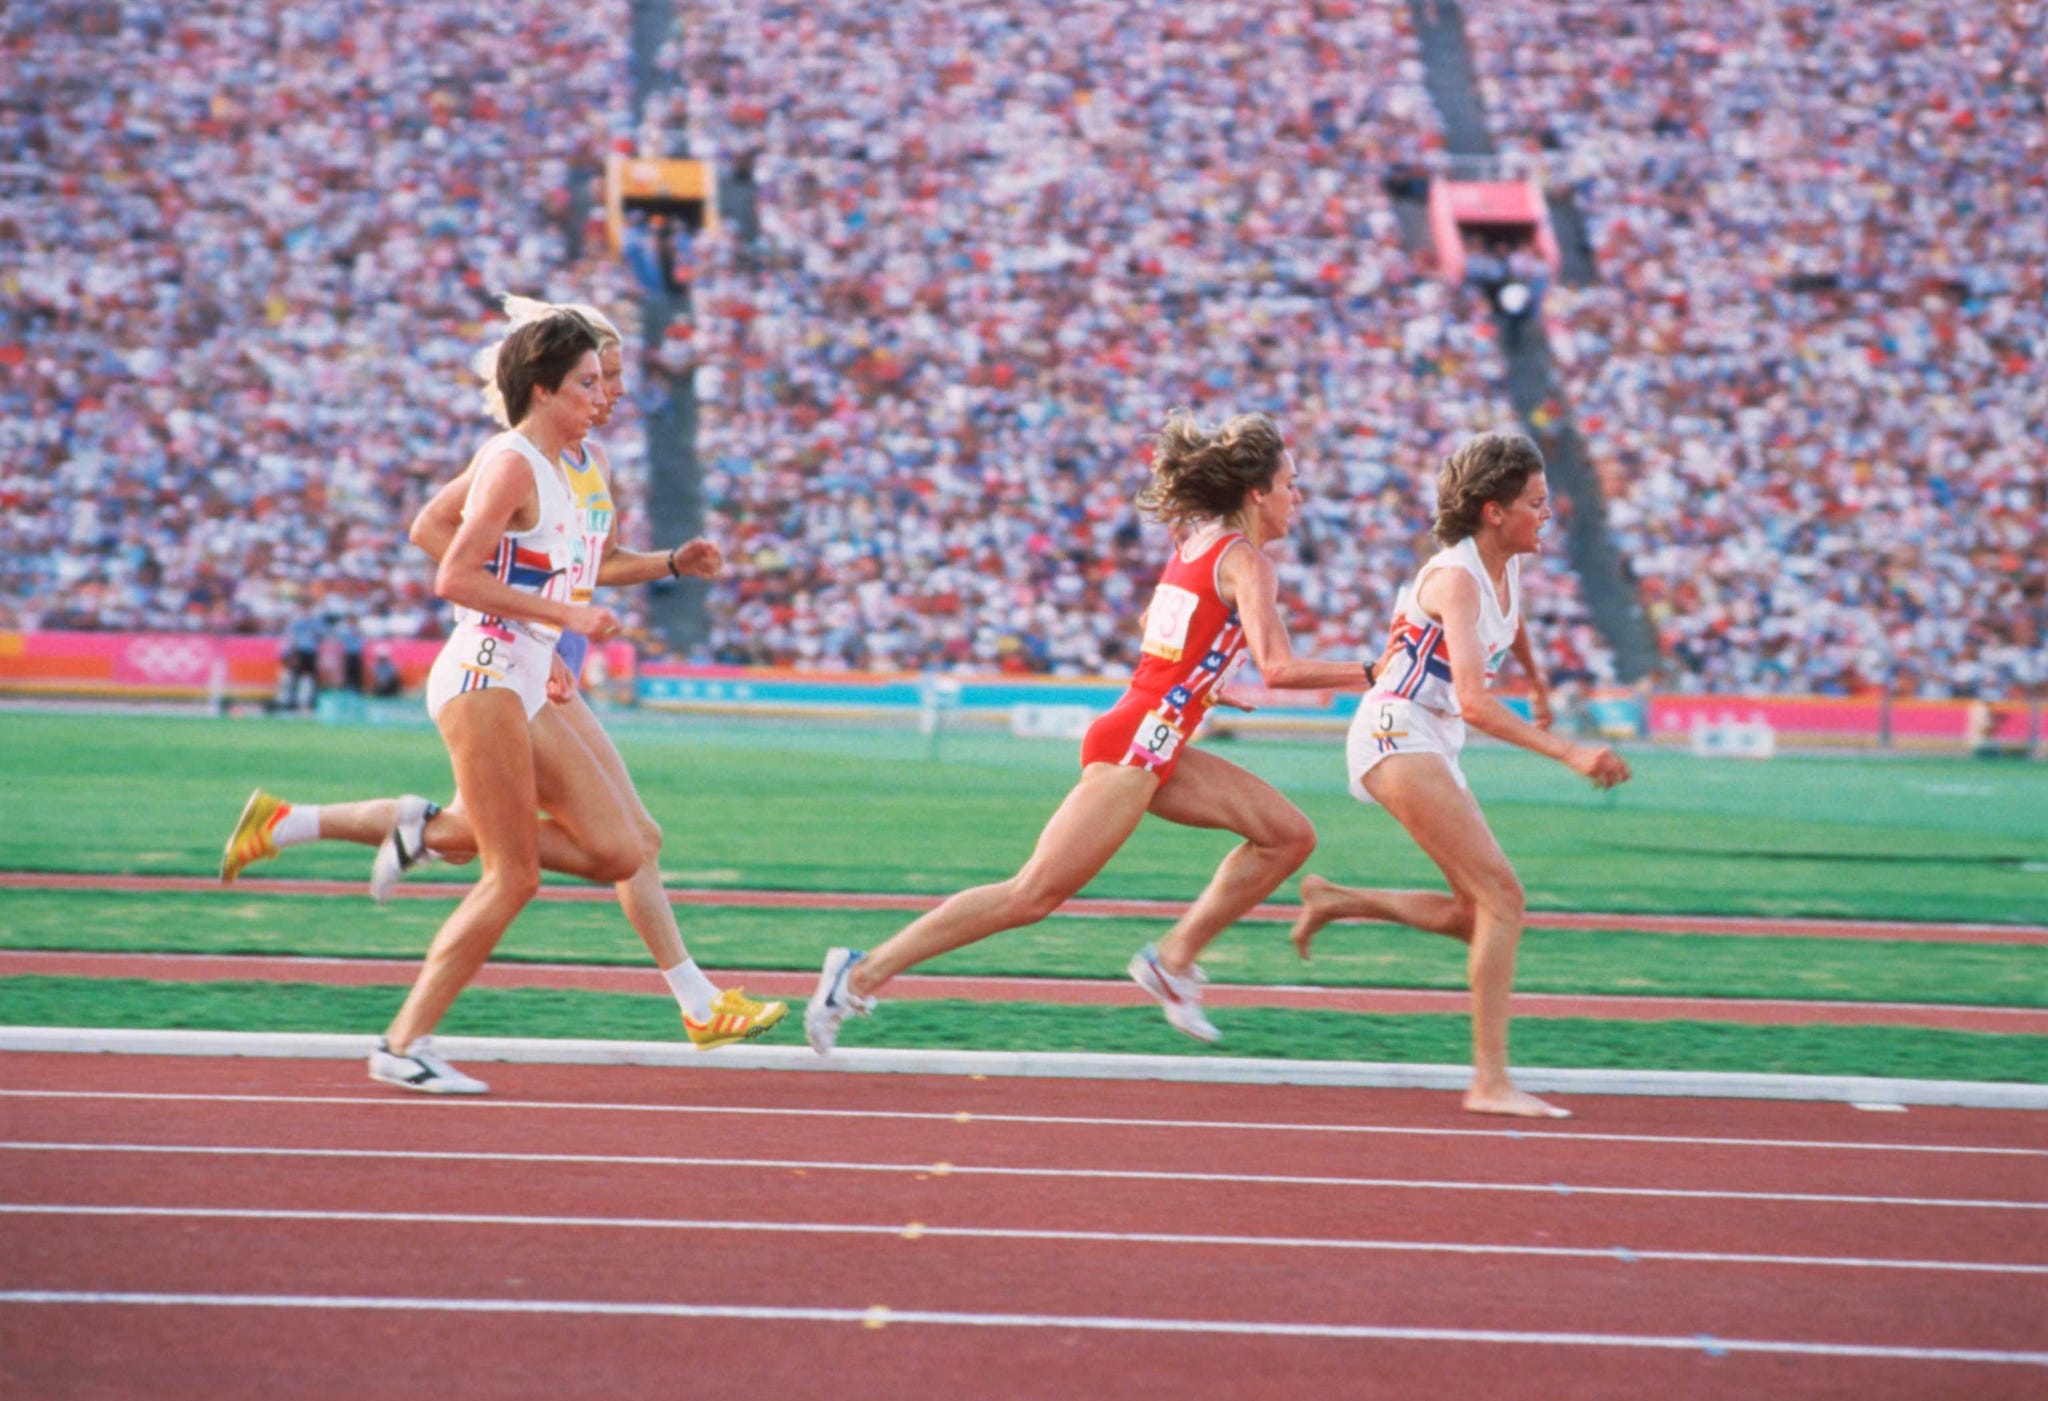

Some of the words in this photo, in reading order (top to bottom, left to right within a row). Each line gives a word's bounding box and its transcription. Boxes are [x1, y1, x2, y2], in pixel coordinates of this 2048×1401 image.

[476, 637, 497, 667] 8
[1380, 703, 1394, 732] 5
[1149, 724, 1170, 751] 9
